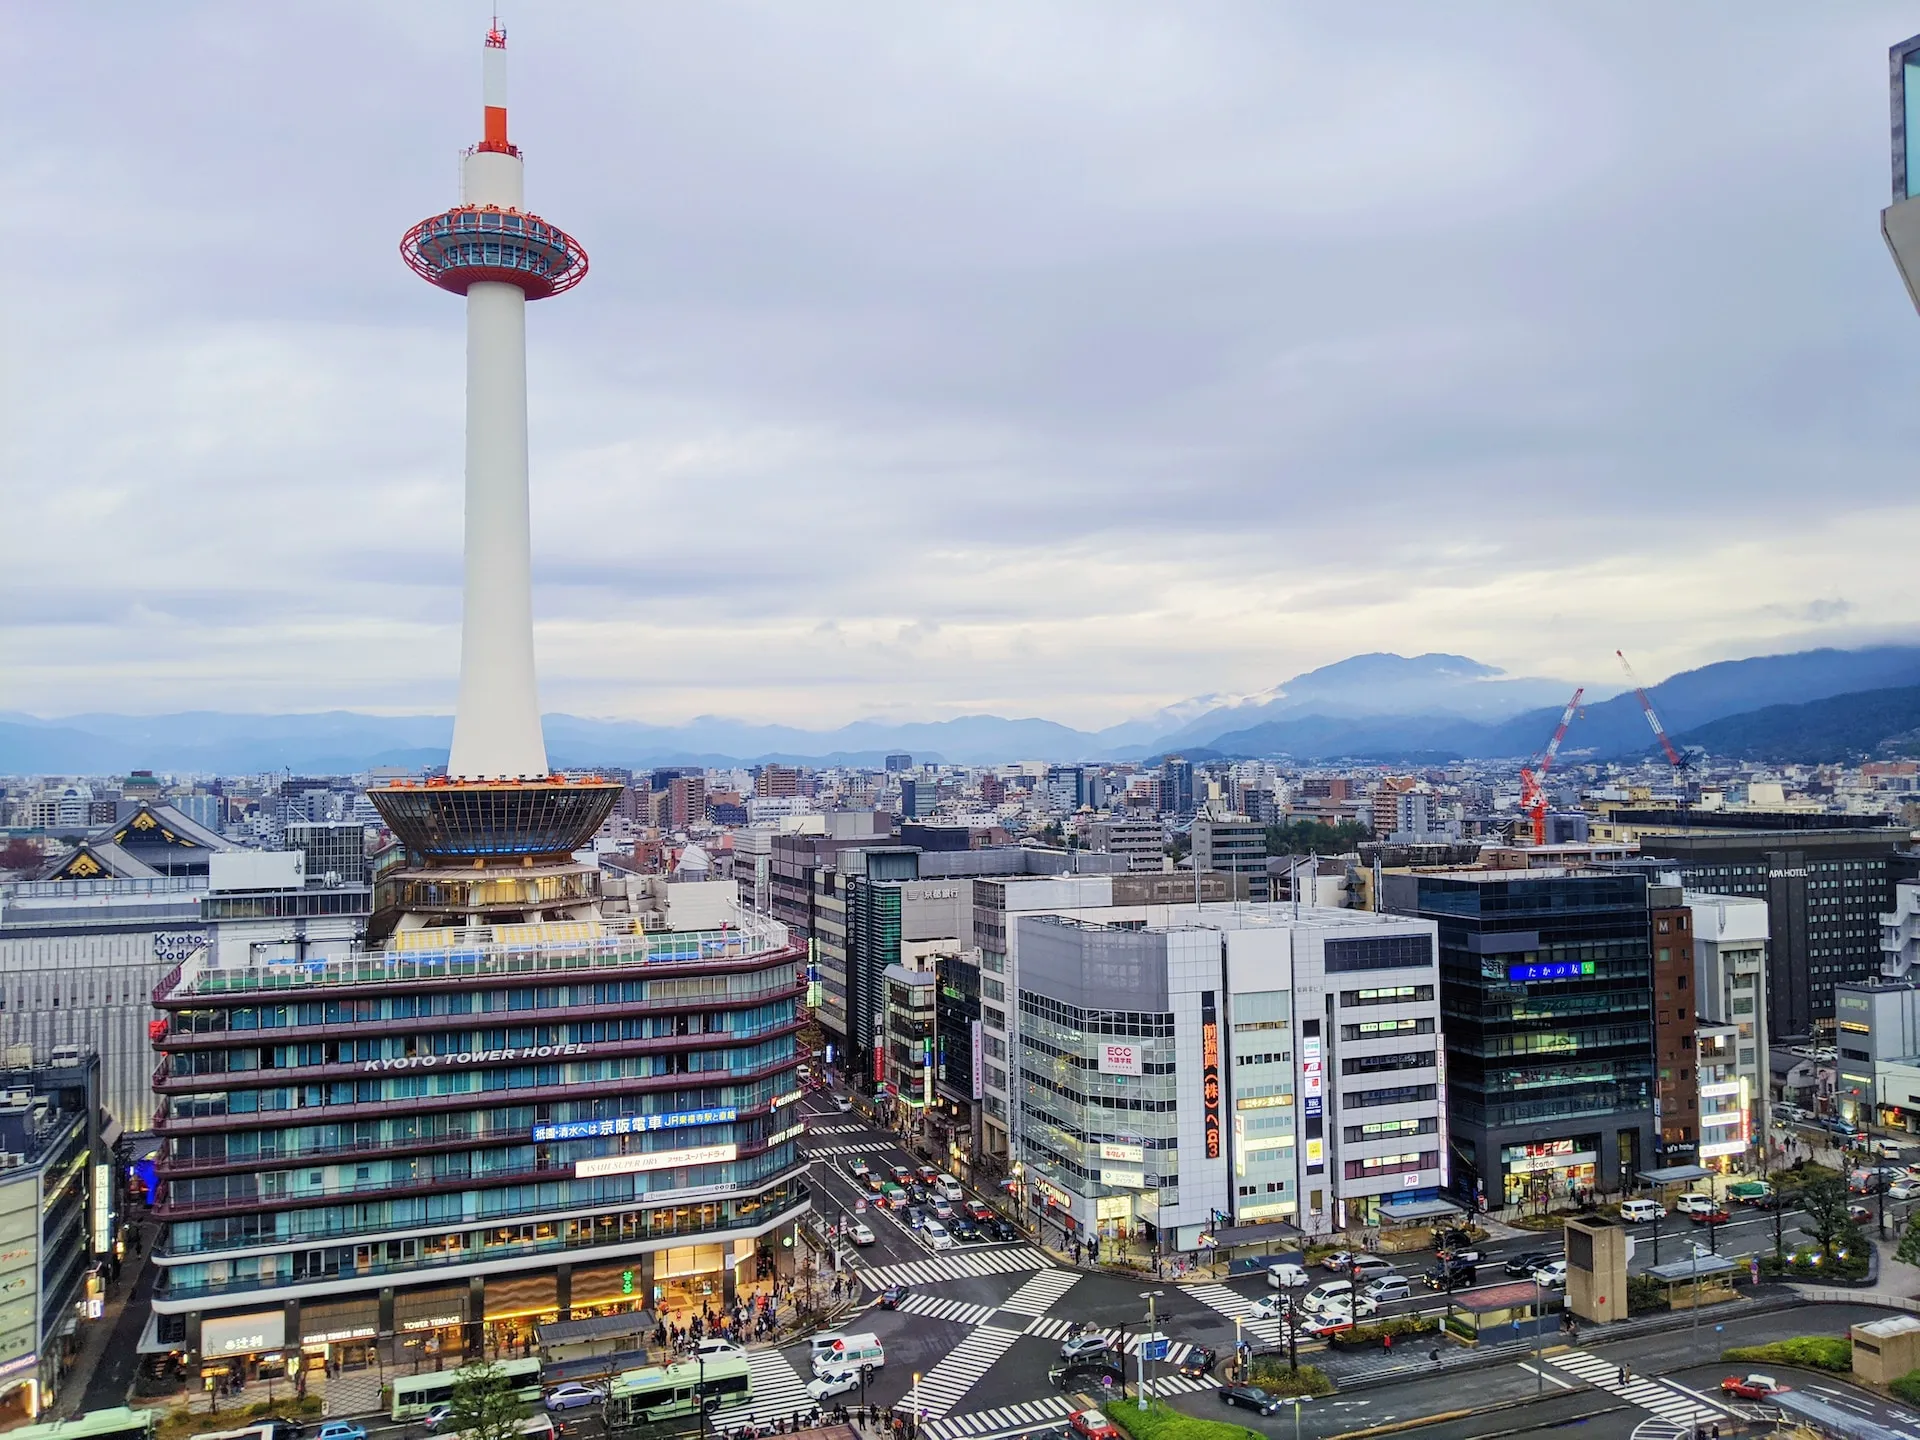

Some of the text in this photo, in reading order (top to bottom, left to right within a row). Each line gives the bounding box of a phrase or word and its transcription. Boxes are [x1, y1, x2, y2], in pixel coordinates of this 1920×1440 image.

[1769, 868, 1808, 878] APA HOTEL
[924, 889, 959, 900] 京都銀行
[154, 933, 202, 947] Kyoto
[364, 1042, 588, 1072] KYOTO TOWER HOTEL
[1107, 1046, 1132, 1057] ECC
[776, 1090, 802, 1108] KEIHAN
[600, 1115, 663, 1136] 京阪電車
[767, 1123, 805, 1147] KYOTO TOWER
[586, 1158, 658, 1172] ASAHI SUPER DRY
[1526, 1161, 1555, 1169] docomo
[1406, 1176, 1417, 1184] JTB
[404, 1316, 460, 1329] TOWER TERRACE
[327, 1331, 351, 1340] TOWER
[353, 1328, 376, 1336] HOTEL
